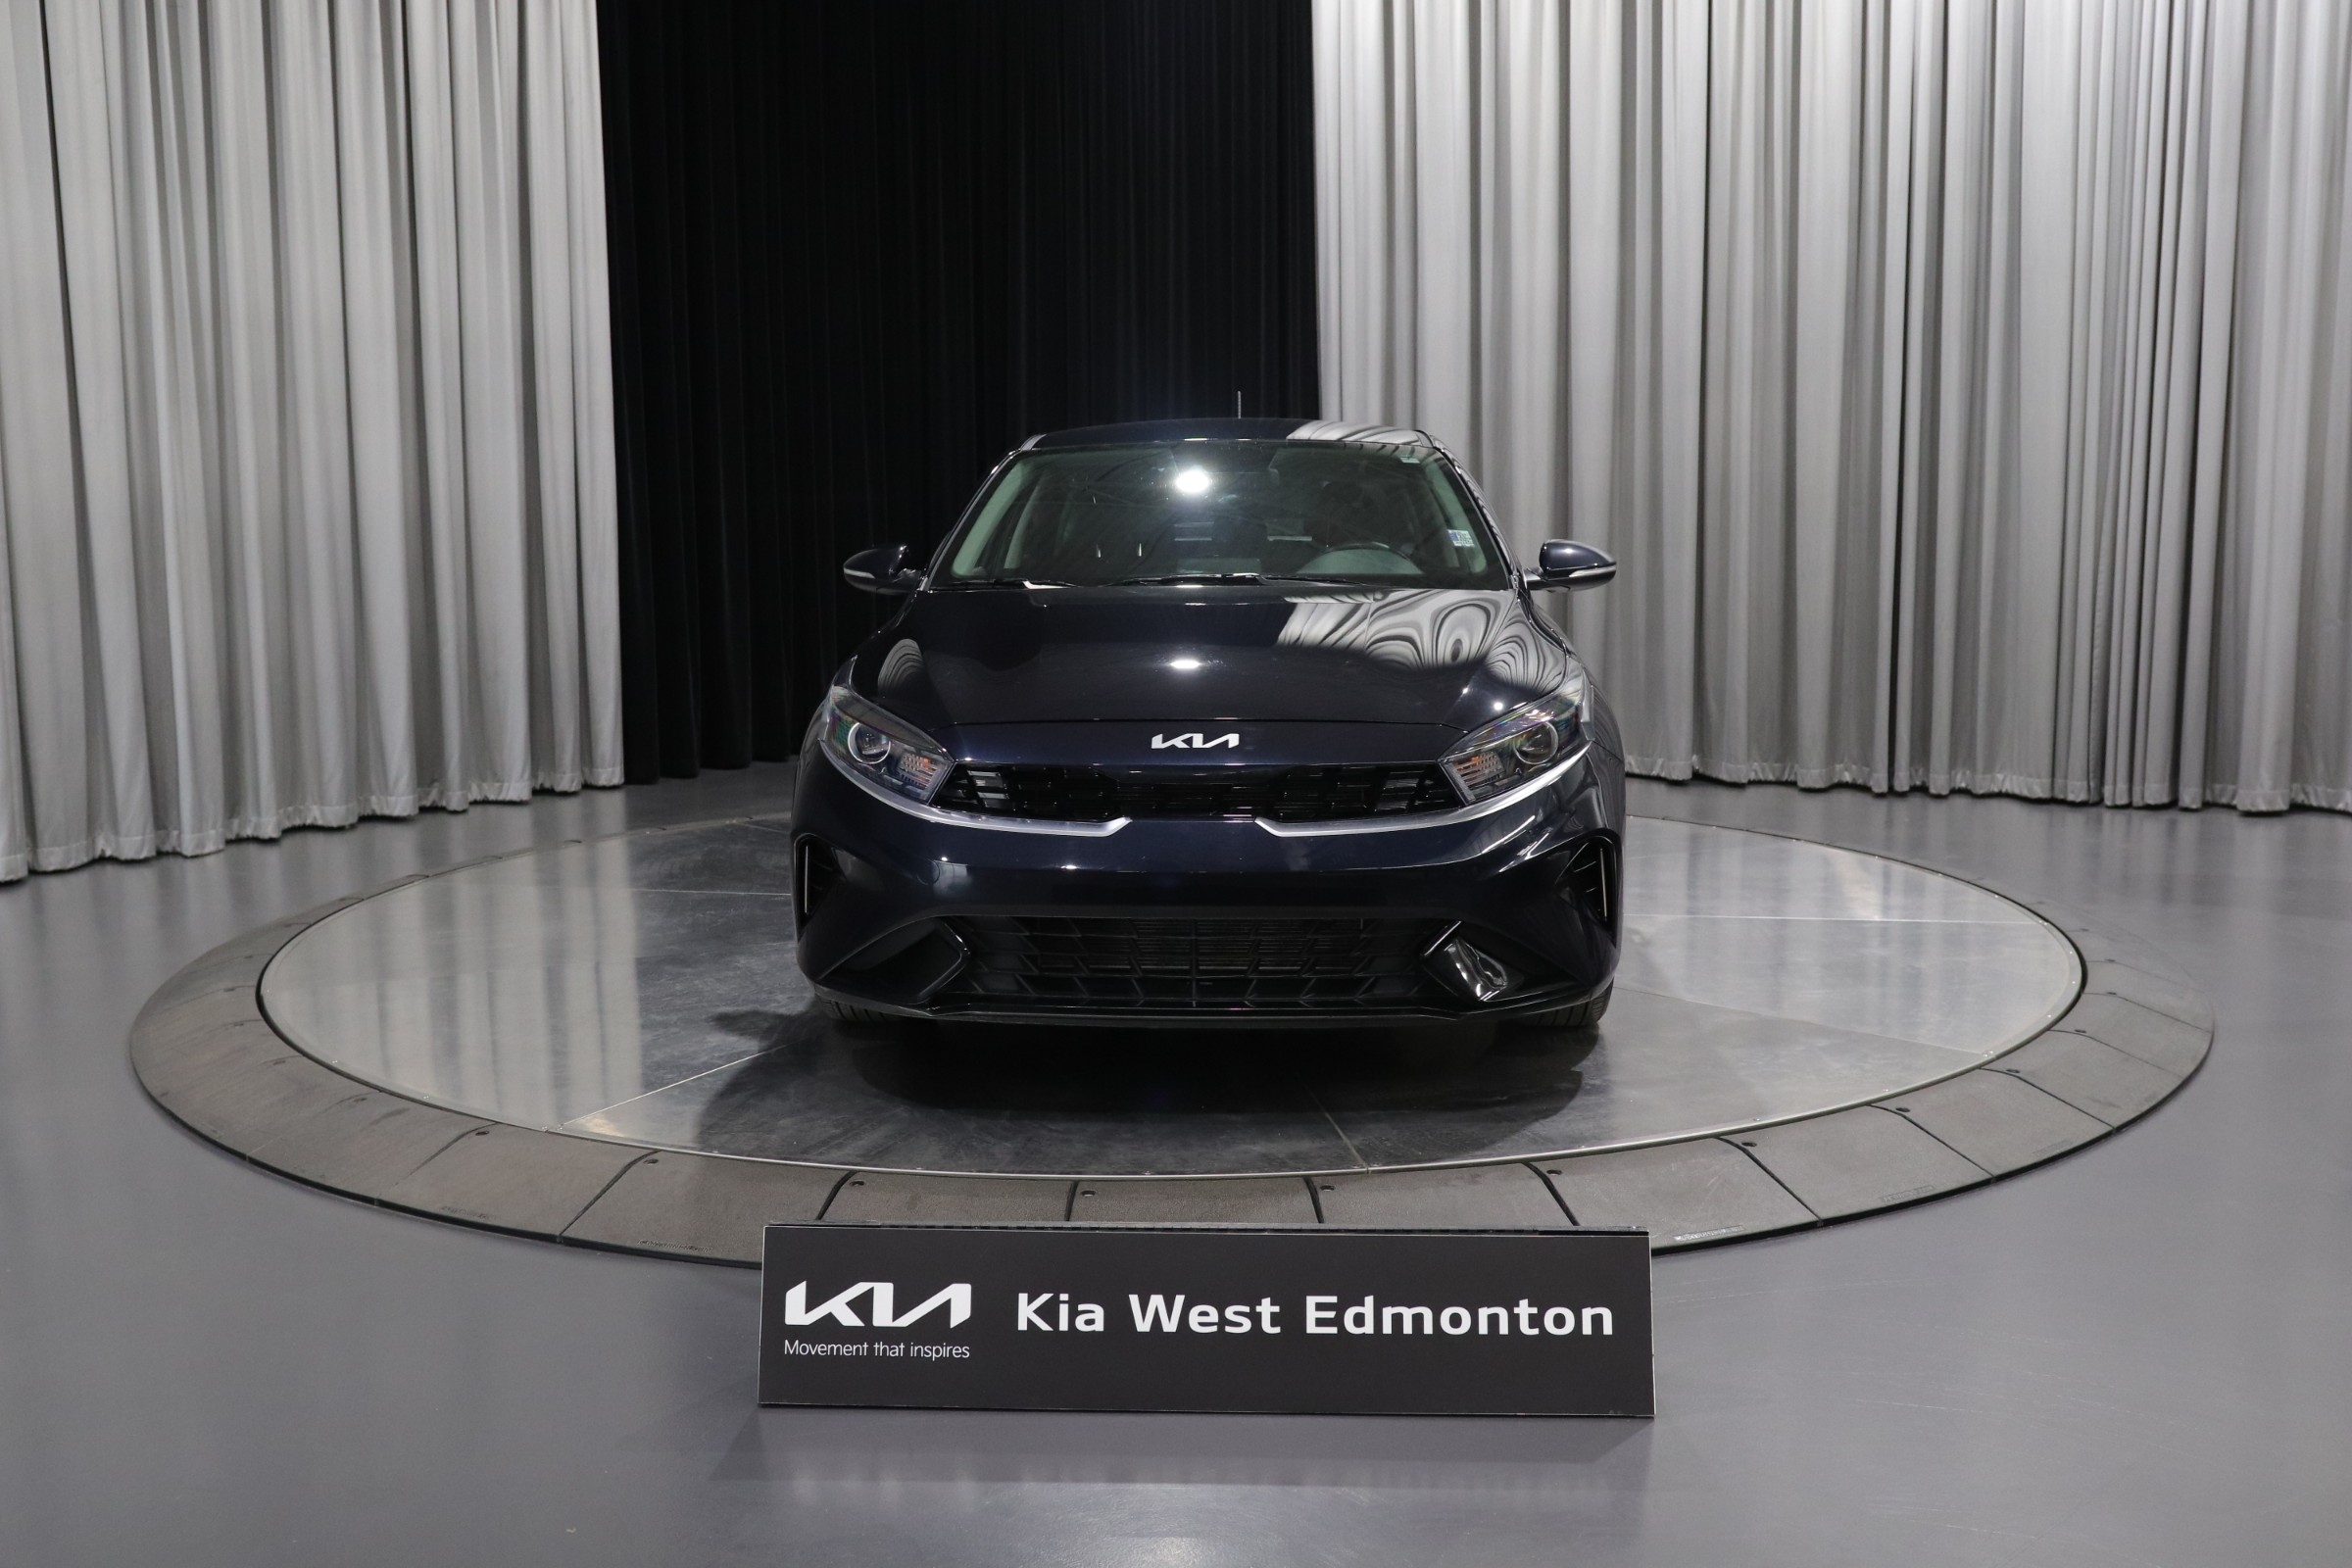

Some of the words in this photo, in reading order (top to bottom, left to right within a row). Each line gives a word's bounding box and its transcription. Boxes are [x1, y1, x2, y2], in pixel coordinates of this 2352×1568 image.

[1151, 732, 1240, 750] KIA
[784, 1280, 972, 1329] KIA
[1017, 1293, 1104, 1333] Kia
[1128, 1294, 1281, 1335] West
[1305, 1295, 1613, 1336] Edmonton
[784, 1339, 868, 1357] Movement
[872, 1341, 905, 1357] that
[909, 1341, 970, 1362] inspires
